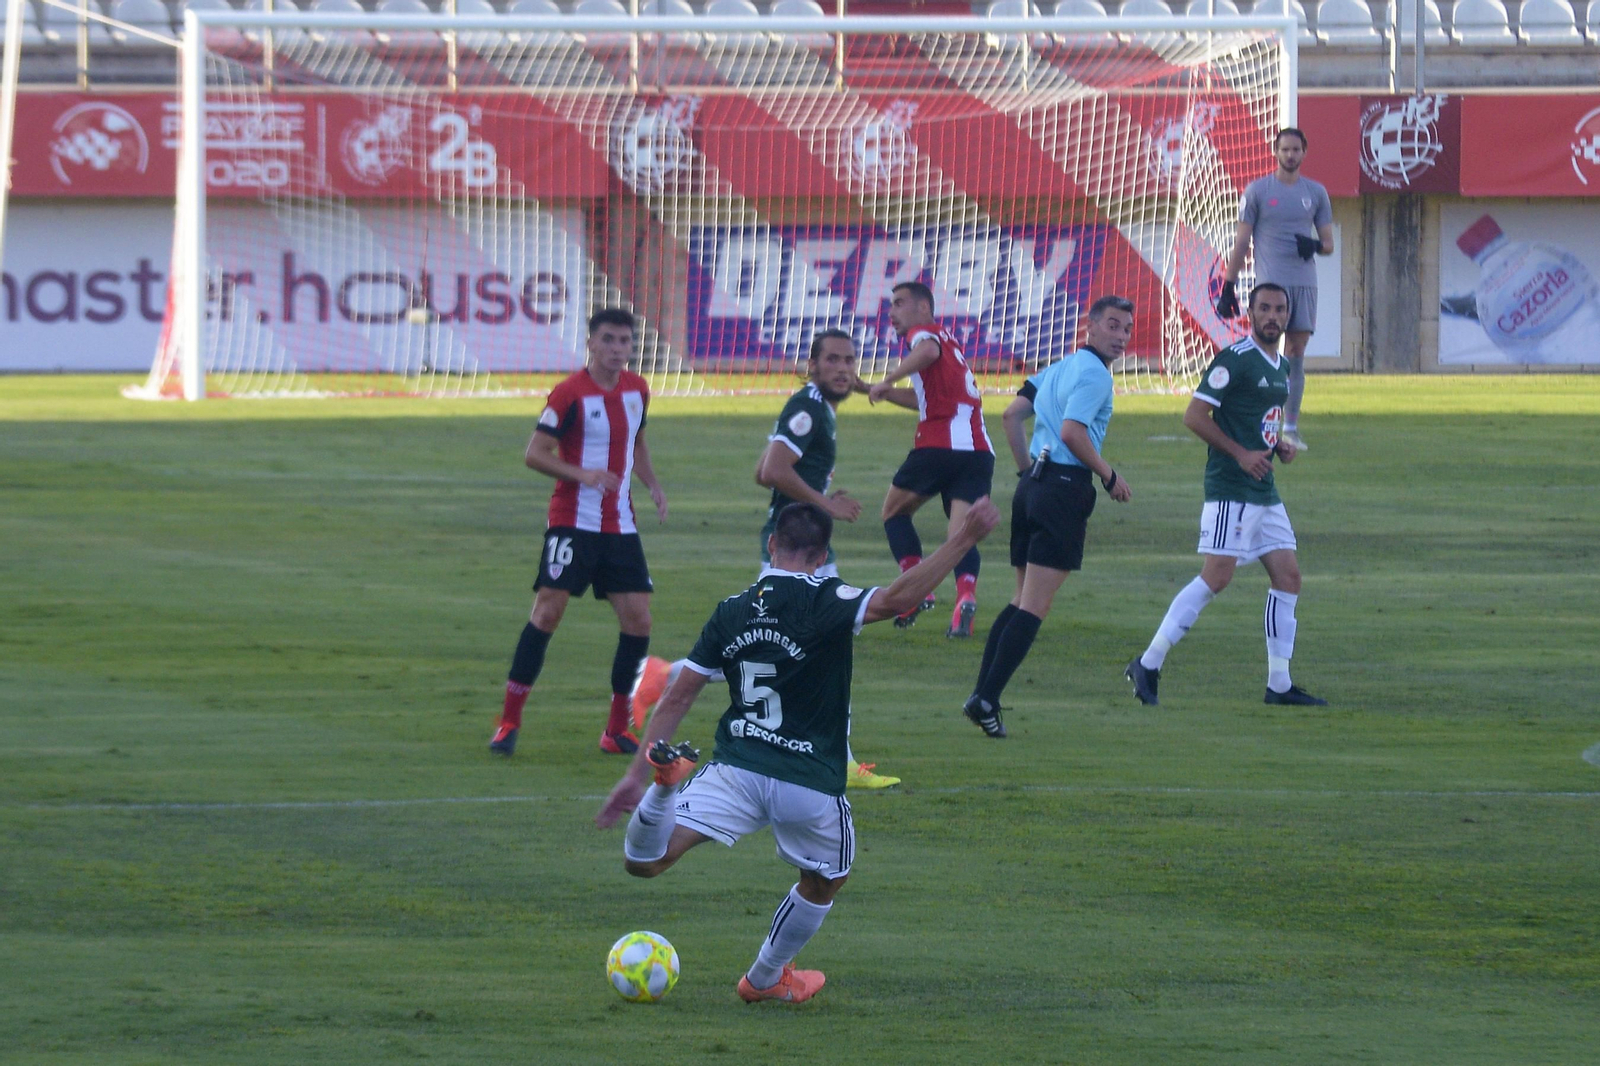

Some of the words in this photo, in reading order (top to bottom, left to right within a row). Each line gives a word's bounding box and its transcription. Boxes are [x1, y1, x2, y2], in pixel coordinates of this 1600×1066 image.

[208, 160, 289, 187] 020
[1, 250, 569, 325] astr.house
[708, 238, 1077, 317] DERBY
[1496, 267, 1569, 334] Cazorla
[548, 536, 574, 566] 16
[740, 660, 783, 732] 5
